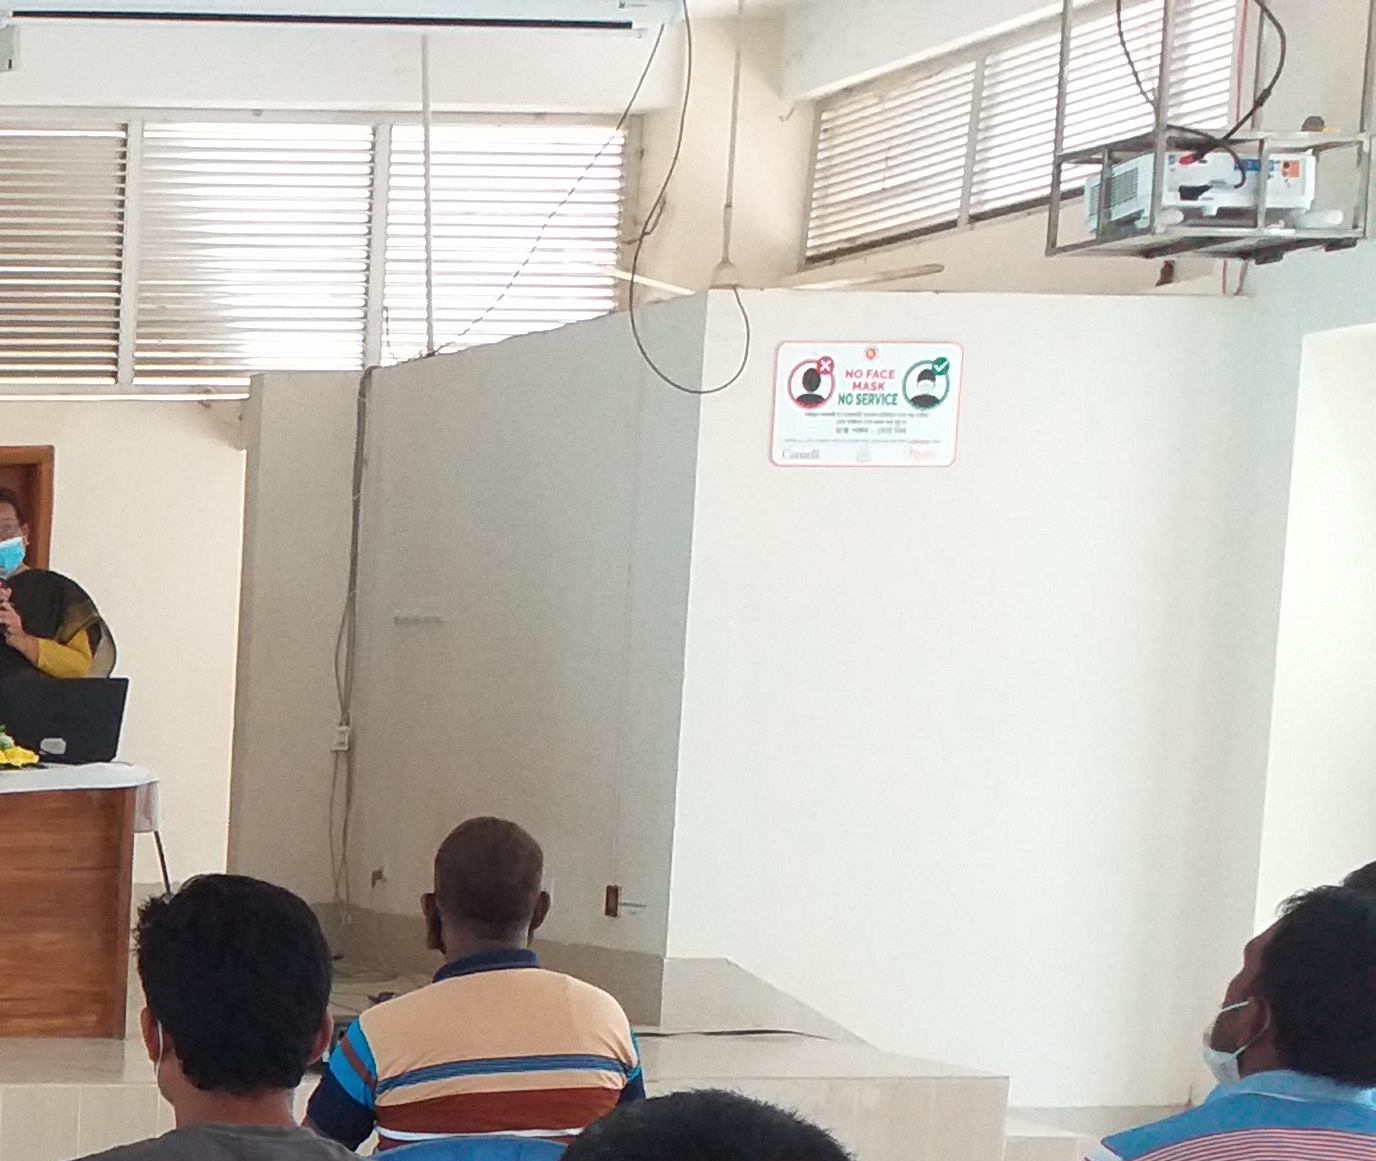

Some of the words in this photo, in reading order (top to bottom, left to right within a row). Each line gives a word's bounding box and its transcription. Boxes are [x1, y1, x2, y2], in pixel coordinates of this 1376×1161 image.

[845, 369, 863, 379] NO
[866, 369, 895, 379] FACE
[852, 381, 886, 391] MASK
[838, 392, 854, 405] NO
[855, 392, 898, 405] SERVICE
